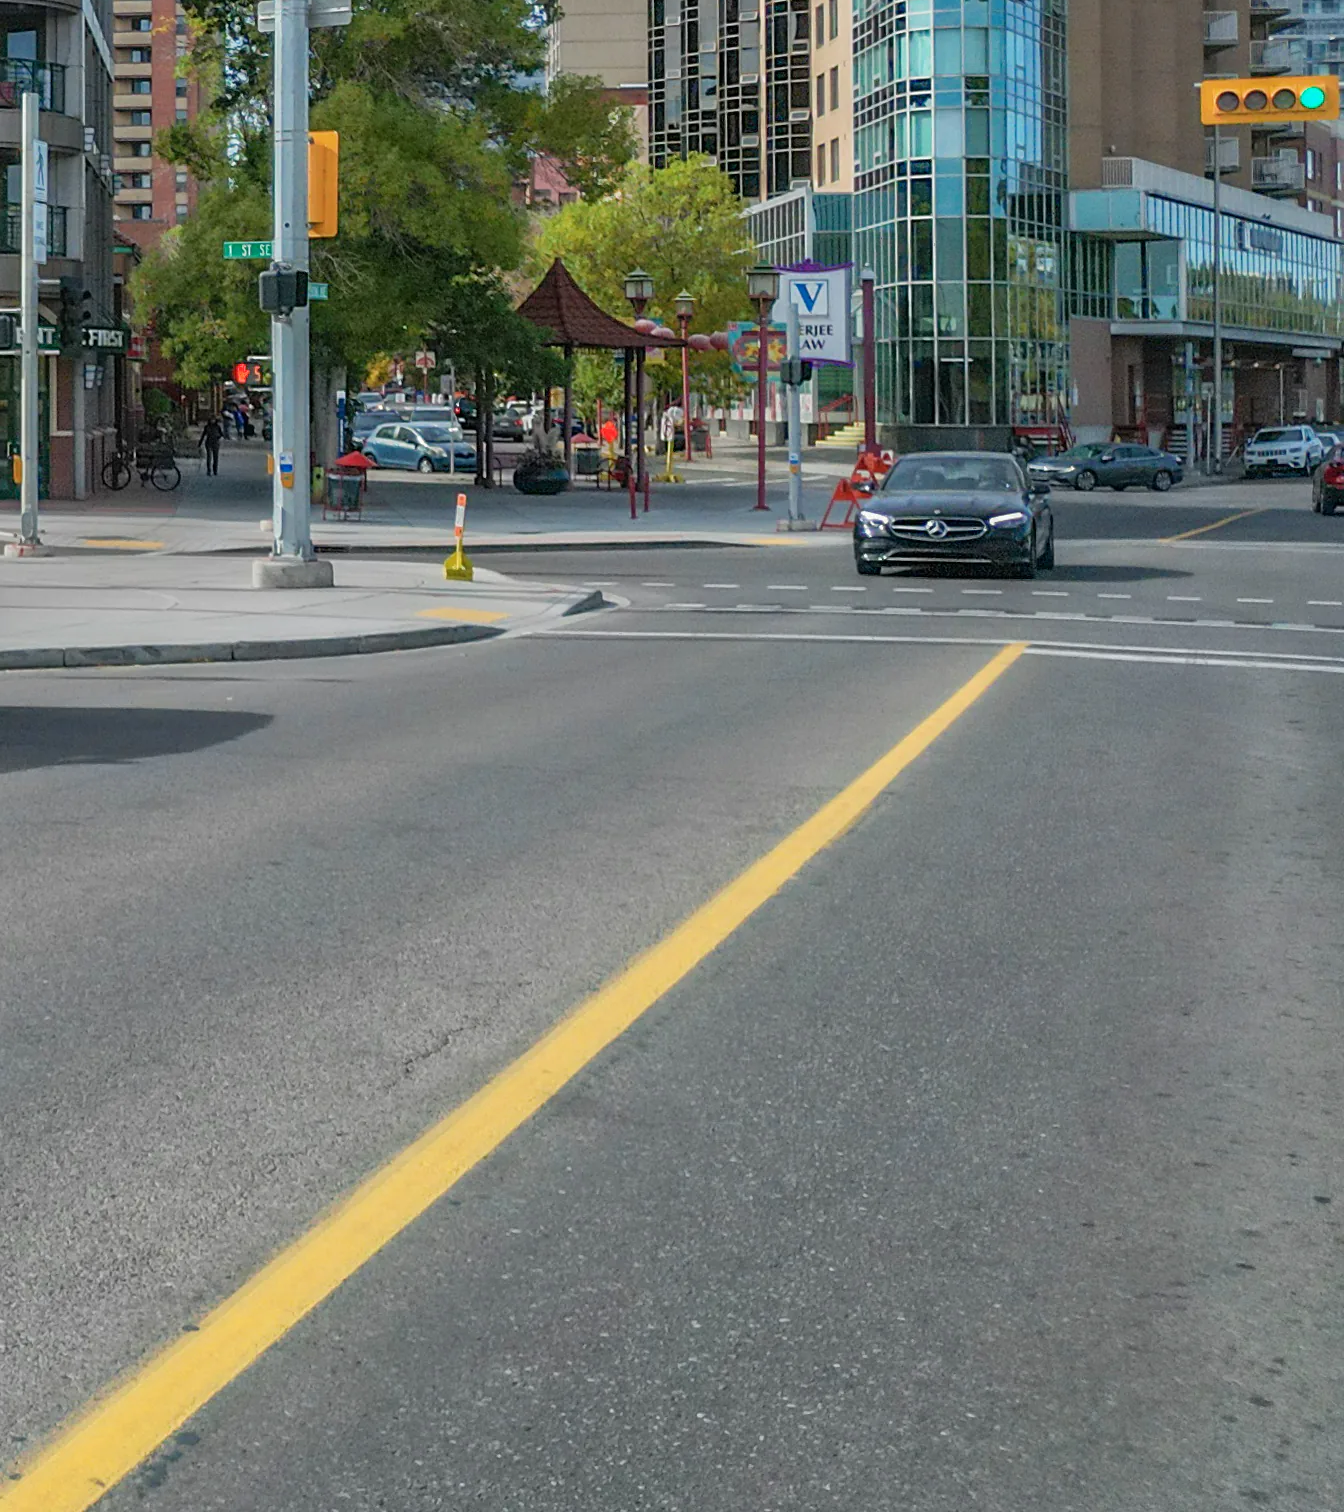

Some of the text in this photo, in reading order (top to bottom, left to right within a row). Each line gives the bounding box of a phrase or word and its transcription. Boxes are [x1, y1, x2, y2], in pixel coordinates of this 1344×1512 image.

[241, 245, 252, 257] ST
[259, 244, 272, 256] SE
[799, 325, 834, 337] ERJEE
[88, 329, 124, 348] FIRST
[801, 339, 826, 350] AW
